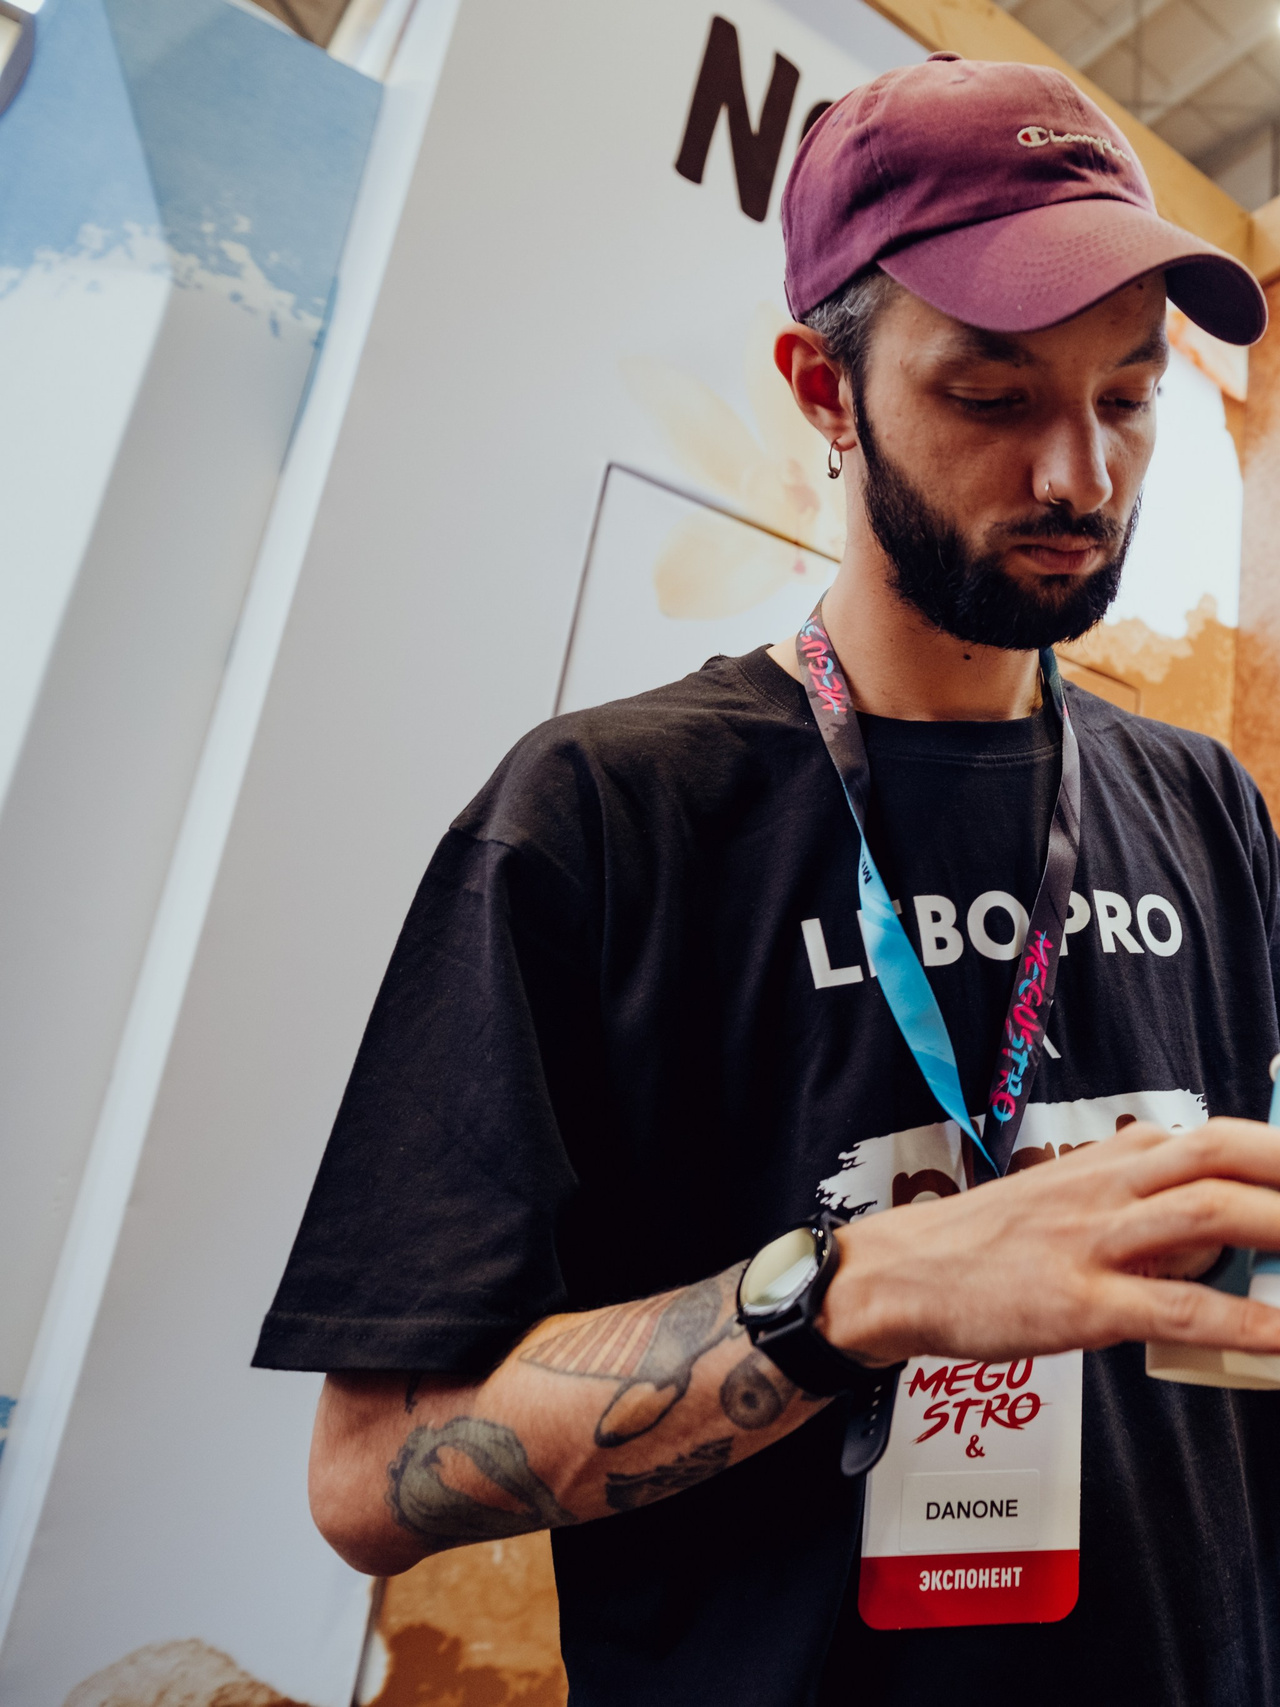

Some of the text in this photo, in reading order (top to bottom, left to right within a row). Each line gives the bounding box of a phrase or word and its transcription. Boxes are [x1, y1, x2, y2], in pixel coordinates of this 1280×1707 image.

[673, 15, 834, 222] N
[1059, 888, 1183, 957] PRO
[904, 1357, 1034, 1401] MEGU
[911, 1392, 1052, 1445] STRO
[965, 1434, 986, 1459] &
[925, 1499, 1019, 1521] DANONE
[919, 1567, 1023, 1592] ЭКСПОНЕНТ
